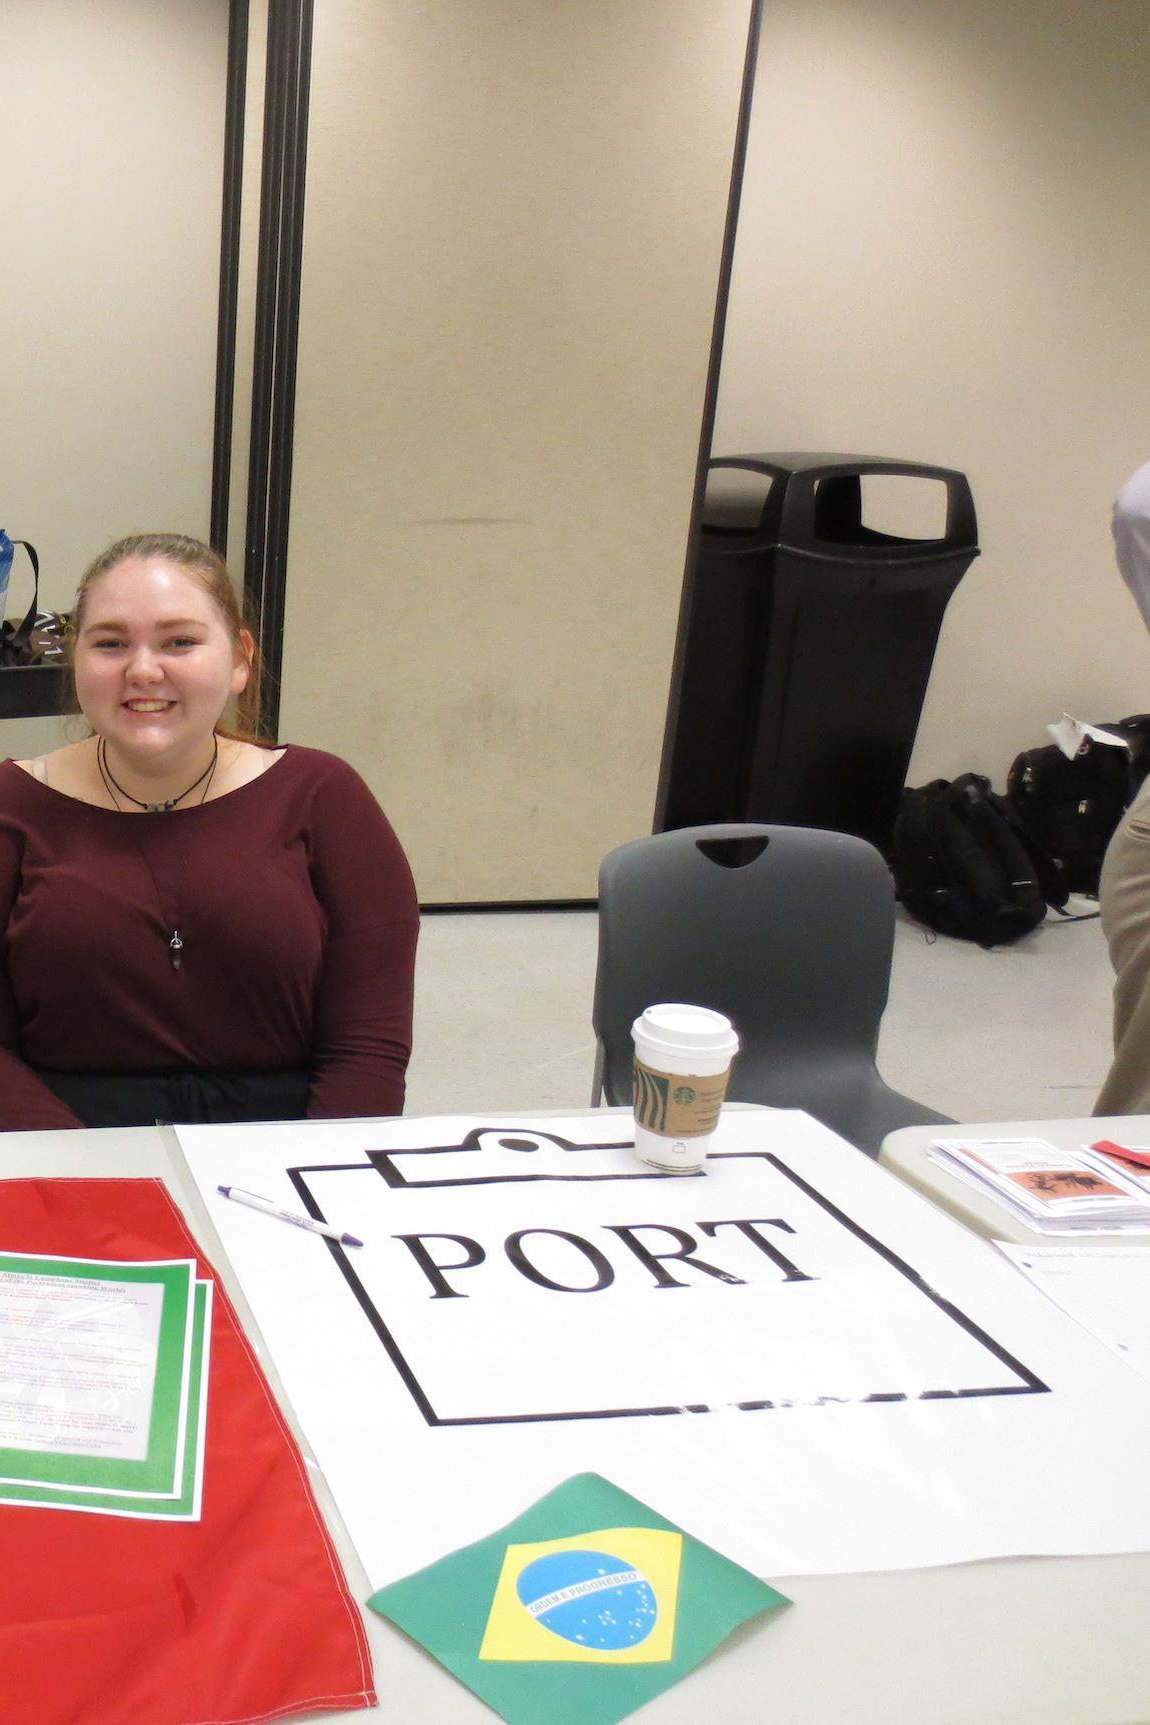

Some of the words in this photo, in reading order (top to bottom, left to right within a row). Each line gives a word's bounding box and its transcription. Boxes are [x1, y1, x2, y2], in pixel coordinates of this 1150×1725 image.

[391, 1218, 821, 1299] PORT
[531, 1595, 560, 1613] ORDEM
[570, 1573, 637, 1596] PROGRESSO
